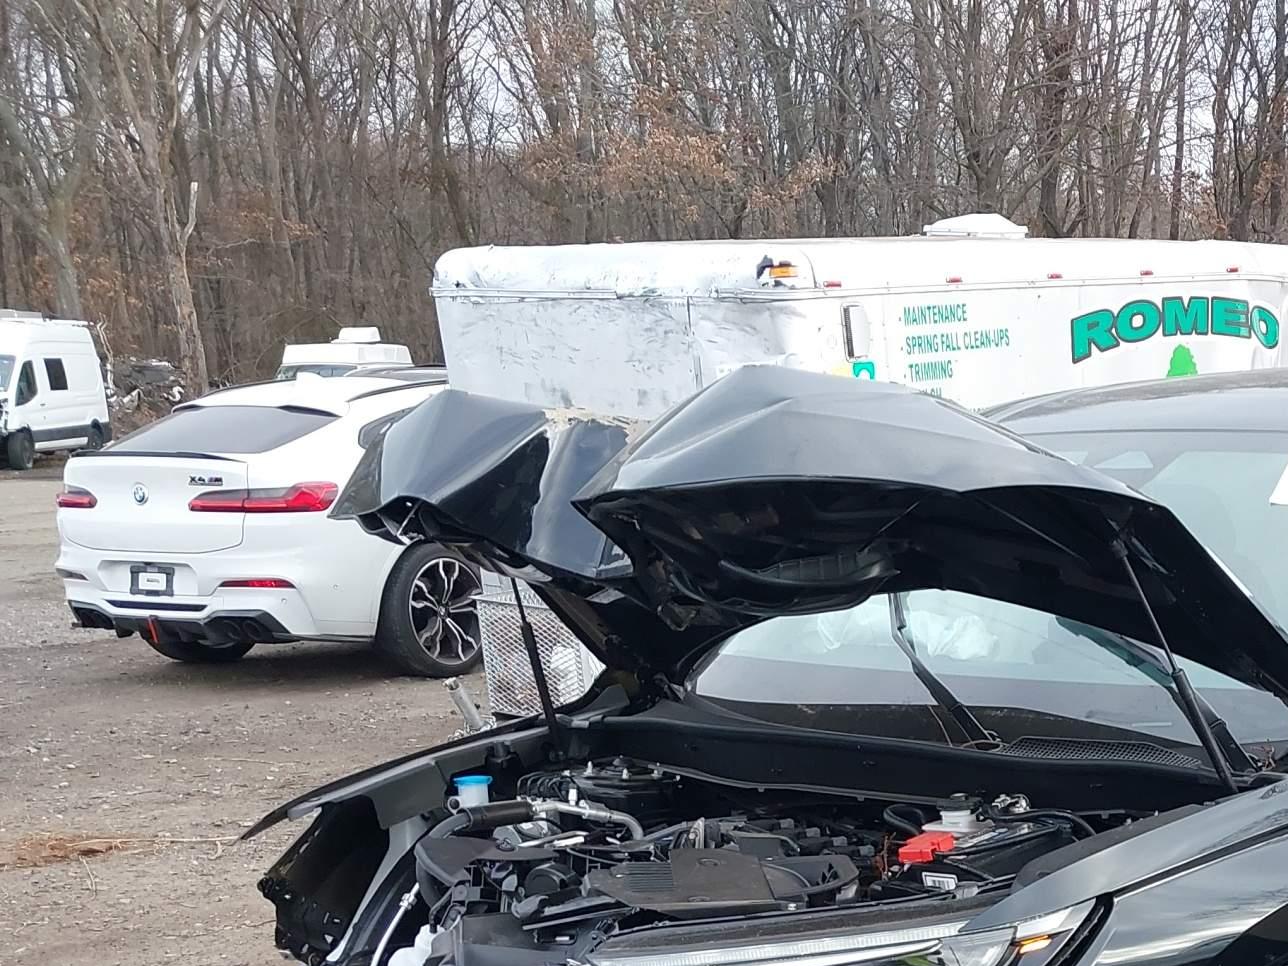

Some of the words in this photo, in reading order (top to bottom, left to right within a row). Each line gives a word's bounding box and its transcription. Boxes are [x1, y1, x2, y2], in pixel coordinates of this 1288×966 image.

[903, 304, 967, 326] MAINTENANCE
[906, 333, 938, 355] SPRING
[941, 332, 961, 353] FALL
[963, 328, 1010, 351] CLEAN-UPS
[1070, 296, 1279, 364] ROMEO
[908, 360, 953, 383] TRIMMING
